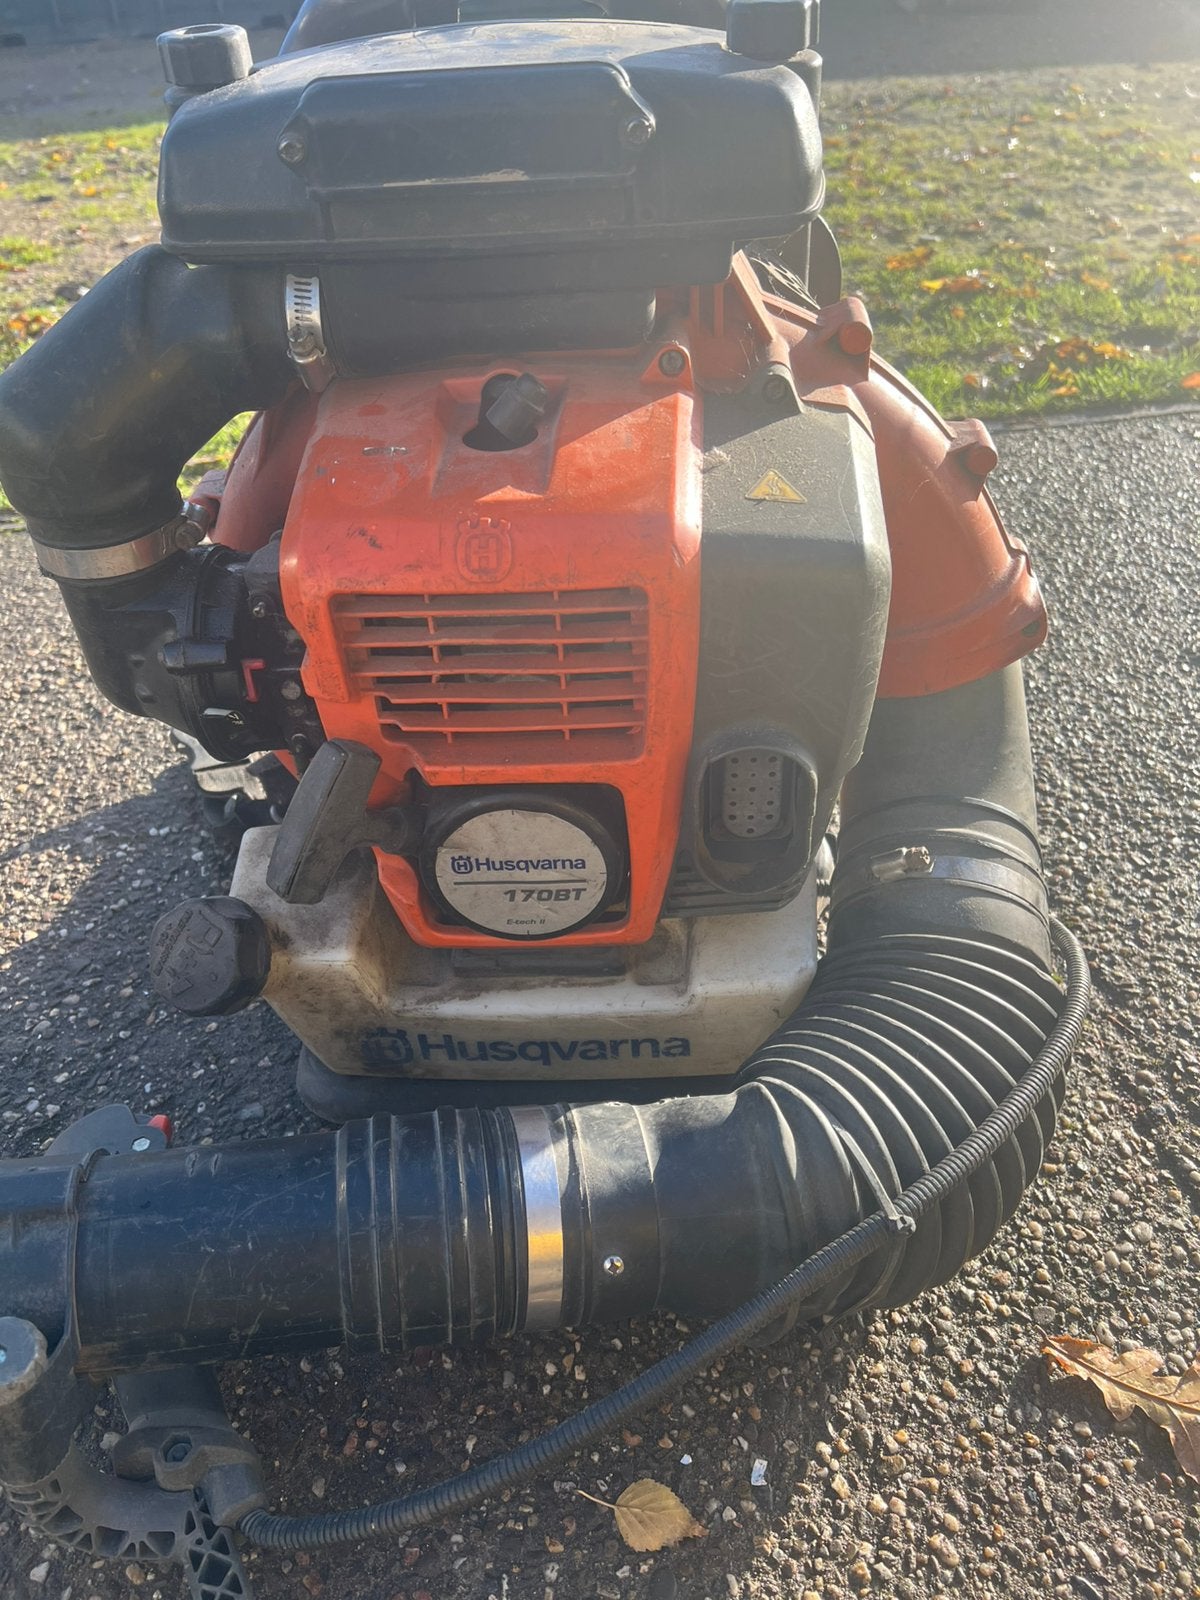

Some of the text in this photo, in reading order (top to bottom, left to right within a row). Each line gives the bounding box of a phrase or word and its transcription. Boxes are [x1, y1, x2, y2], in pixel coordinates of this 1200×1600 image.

[475, 857, 586, 873] Husqvarna
[503, 887, 587, 902] 170BT
[416, 1033, 692, 1067] Husqvarna
